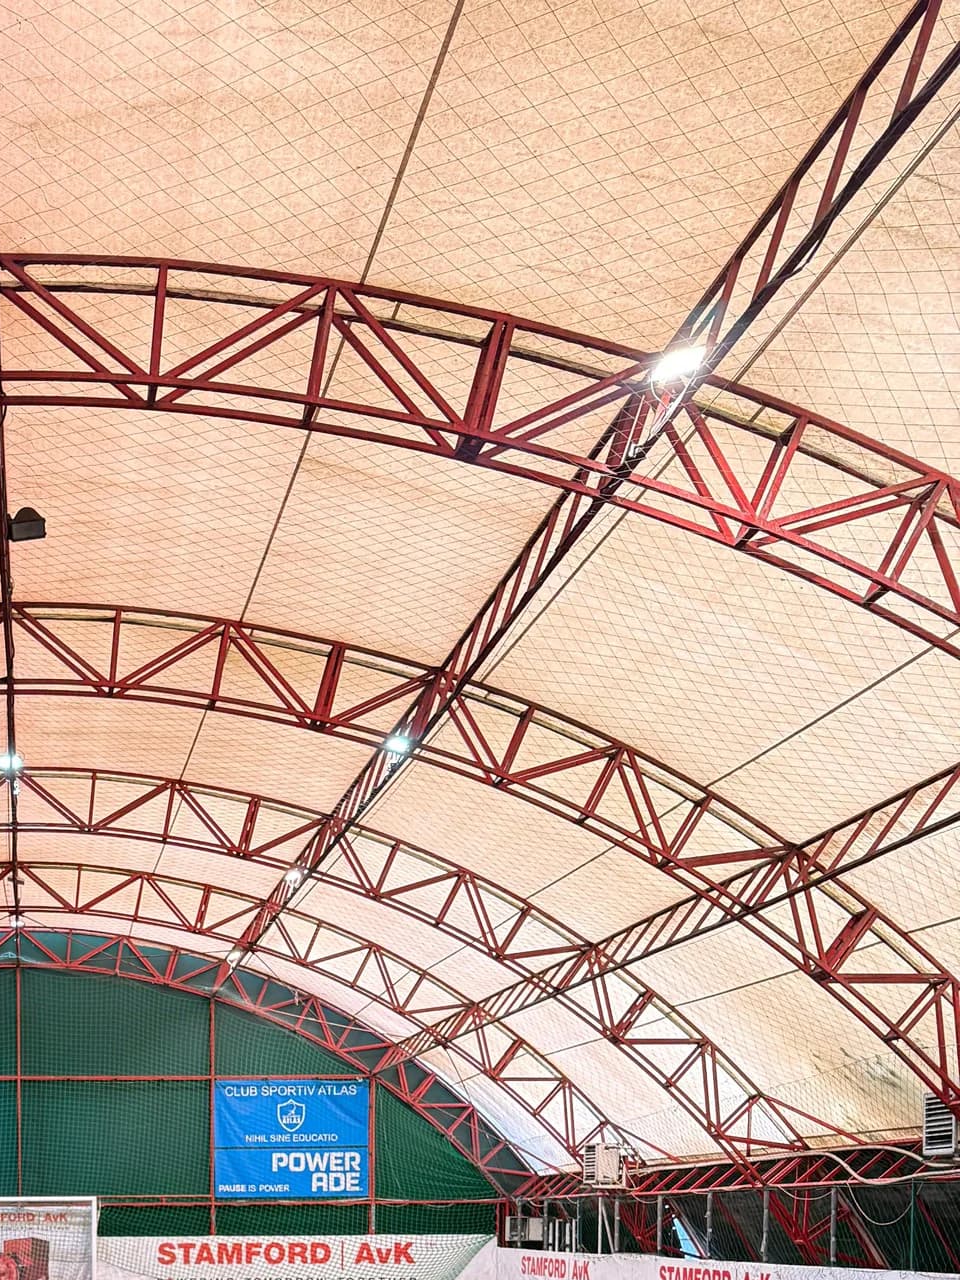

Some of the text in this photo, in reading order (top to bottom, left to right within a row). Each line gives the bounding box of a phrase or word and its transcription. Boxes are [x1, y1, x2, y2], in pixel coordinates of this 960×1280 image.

[224, 1084, 357, 1097] CLUB SPORTIV ATLAS
[245, 1133, 339, 1143] NIHIL SINE EDUCATIO
[271, 1151, 361, 1172] POWER
[218, 1184, 290, 1193] PAUSE IS POWER
[311, 1172, 361, 1192] ADE
[43, 1212, 68, 1223] AvK
[157, 1241, 416, 1265] STAMFORD AvK
[521, 1256, 590, 1280] STAMFORD AvK
